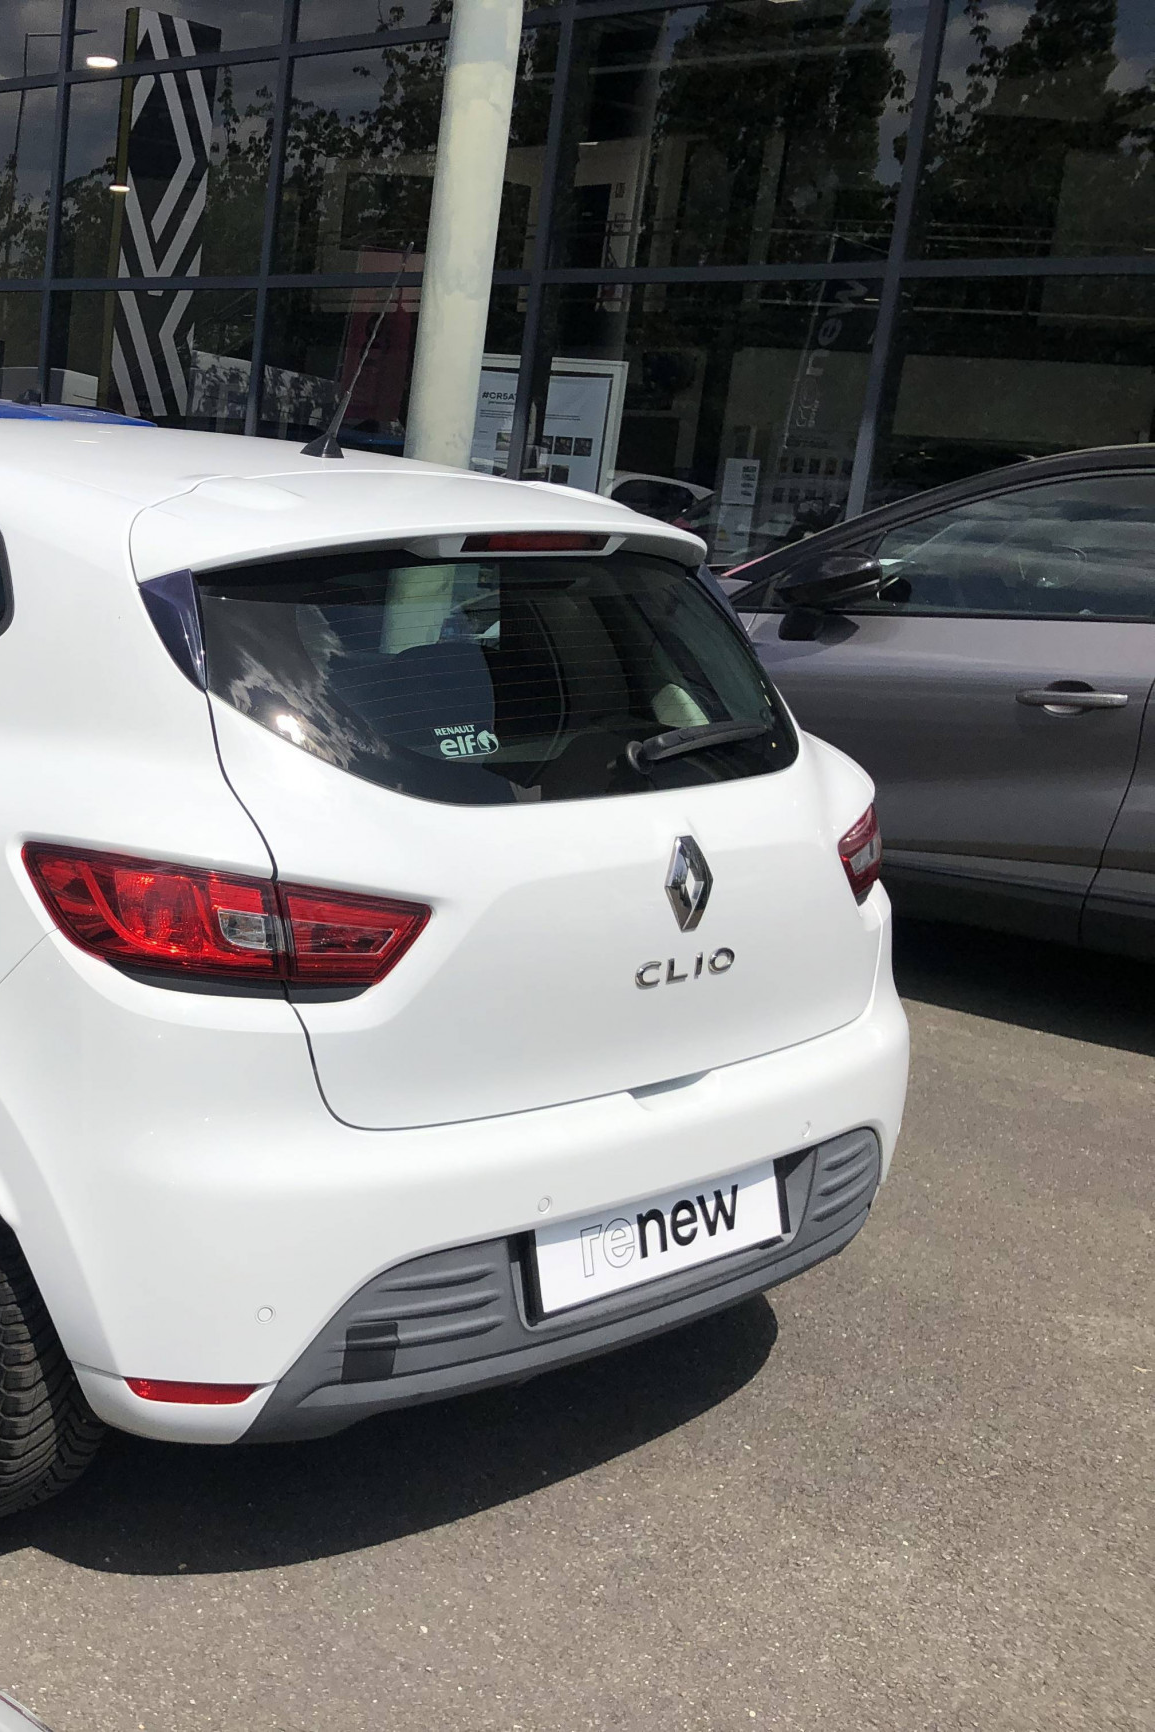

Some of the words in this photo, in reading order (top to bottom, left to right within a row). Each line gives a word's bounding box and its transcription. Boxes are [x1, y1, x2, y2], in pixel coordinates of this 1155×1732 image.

[434, 724, 476, 736] RENAULT
[439, 734, 478, 756] elf
[634, 947, 736, 990] CLIO
[579, 1184, 739, 1278] renew
